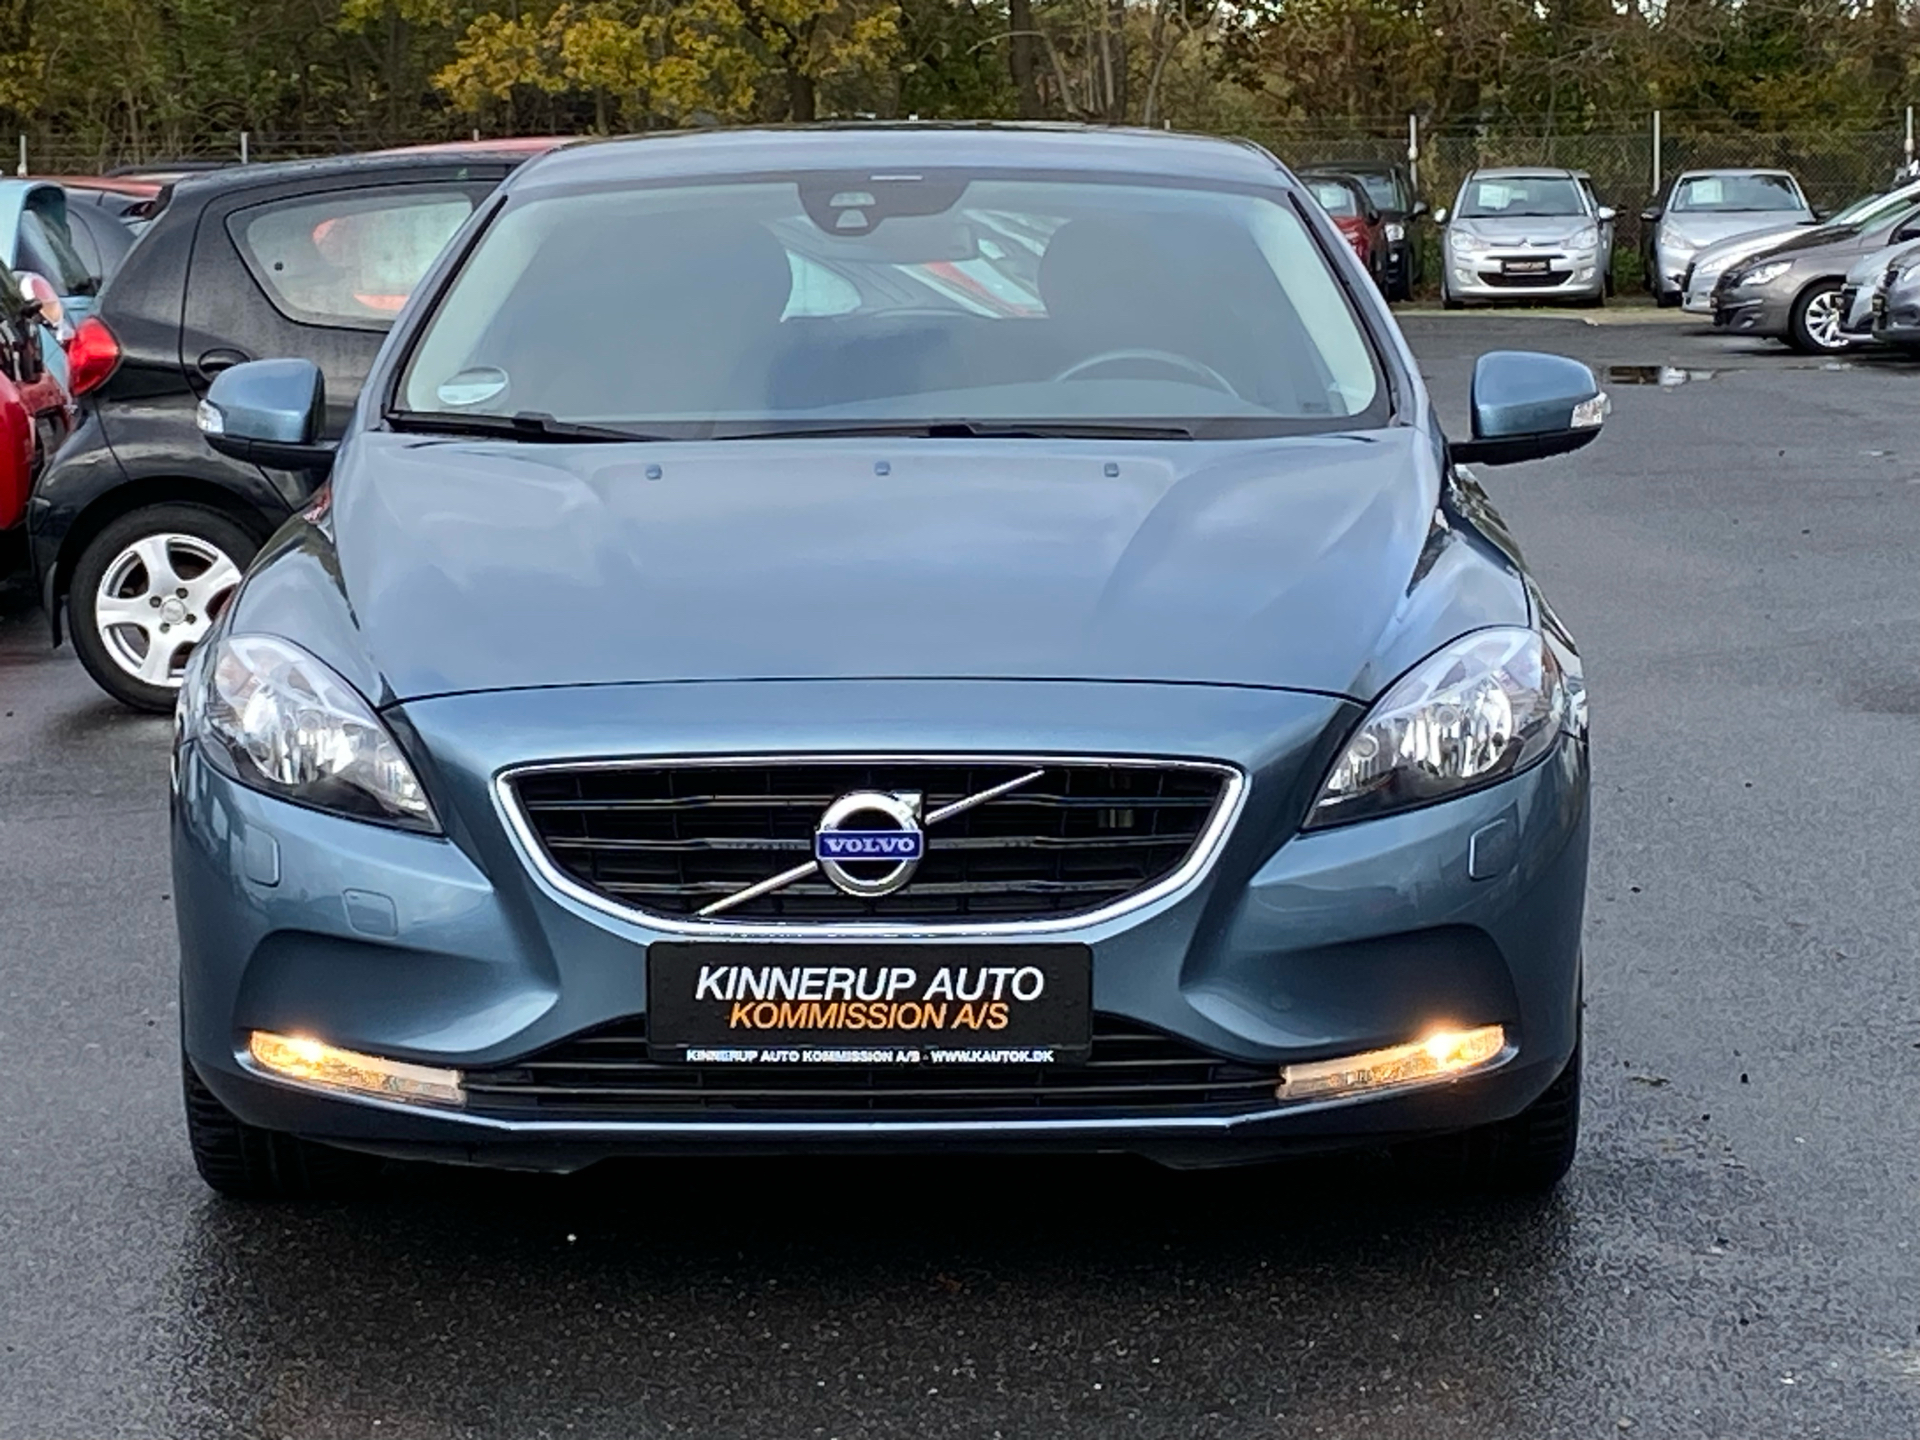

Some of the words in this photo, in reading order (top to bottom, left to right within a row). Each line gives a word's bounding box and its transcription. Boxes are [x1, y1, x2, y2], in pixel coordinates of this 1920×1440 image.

[824, 837, 915, 853] VOLVO
[695, 966, 917, 1001] KINNERUP
[923, 966, 1045, 1001] AUTO
[729, 1002, 949, 1030] KOMMISSION
[951, 1002, 1010, 1030] A/S
[686, 1050, 758, 1063] KINNERUP
[760, 1050, 799, 1063] AUTO
[802, 1050, 894, 1063] KOMMISSION
